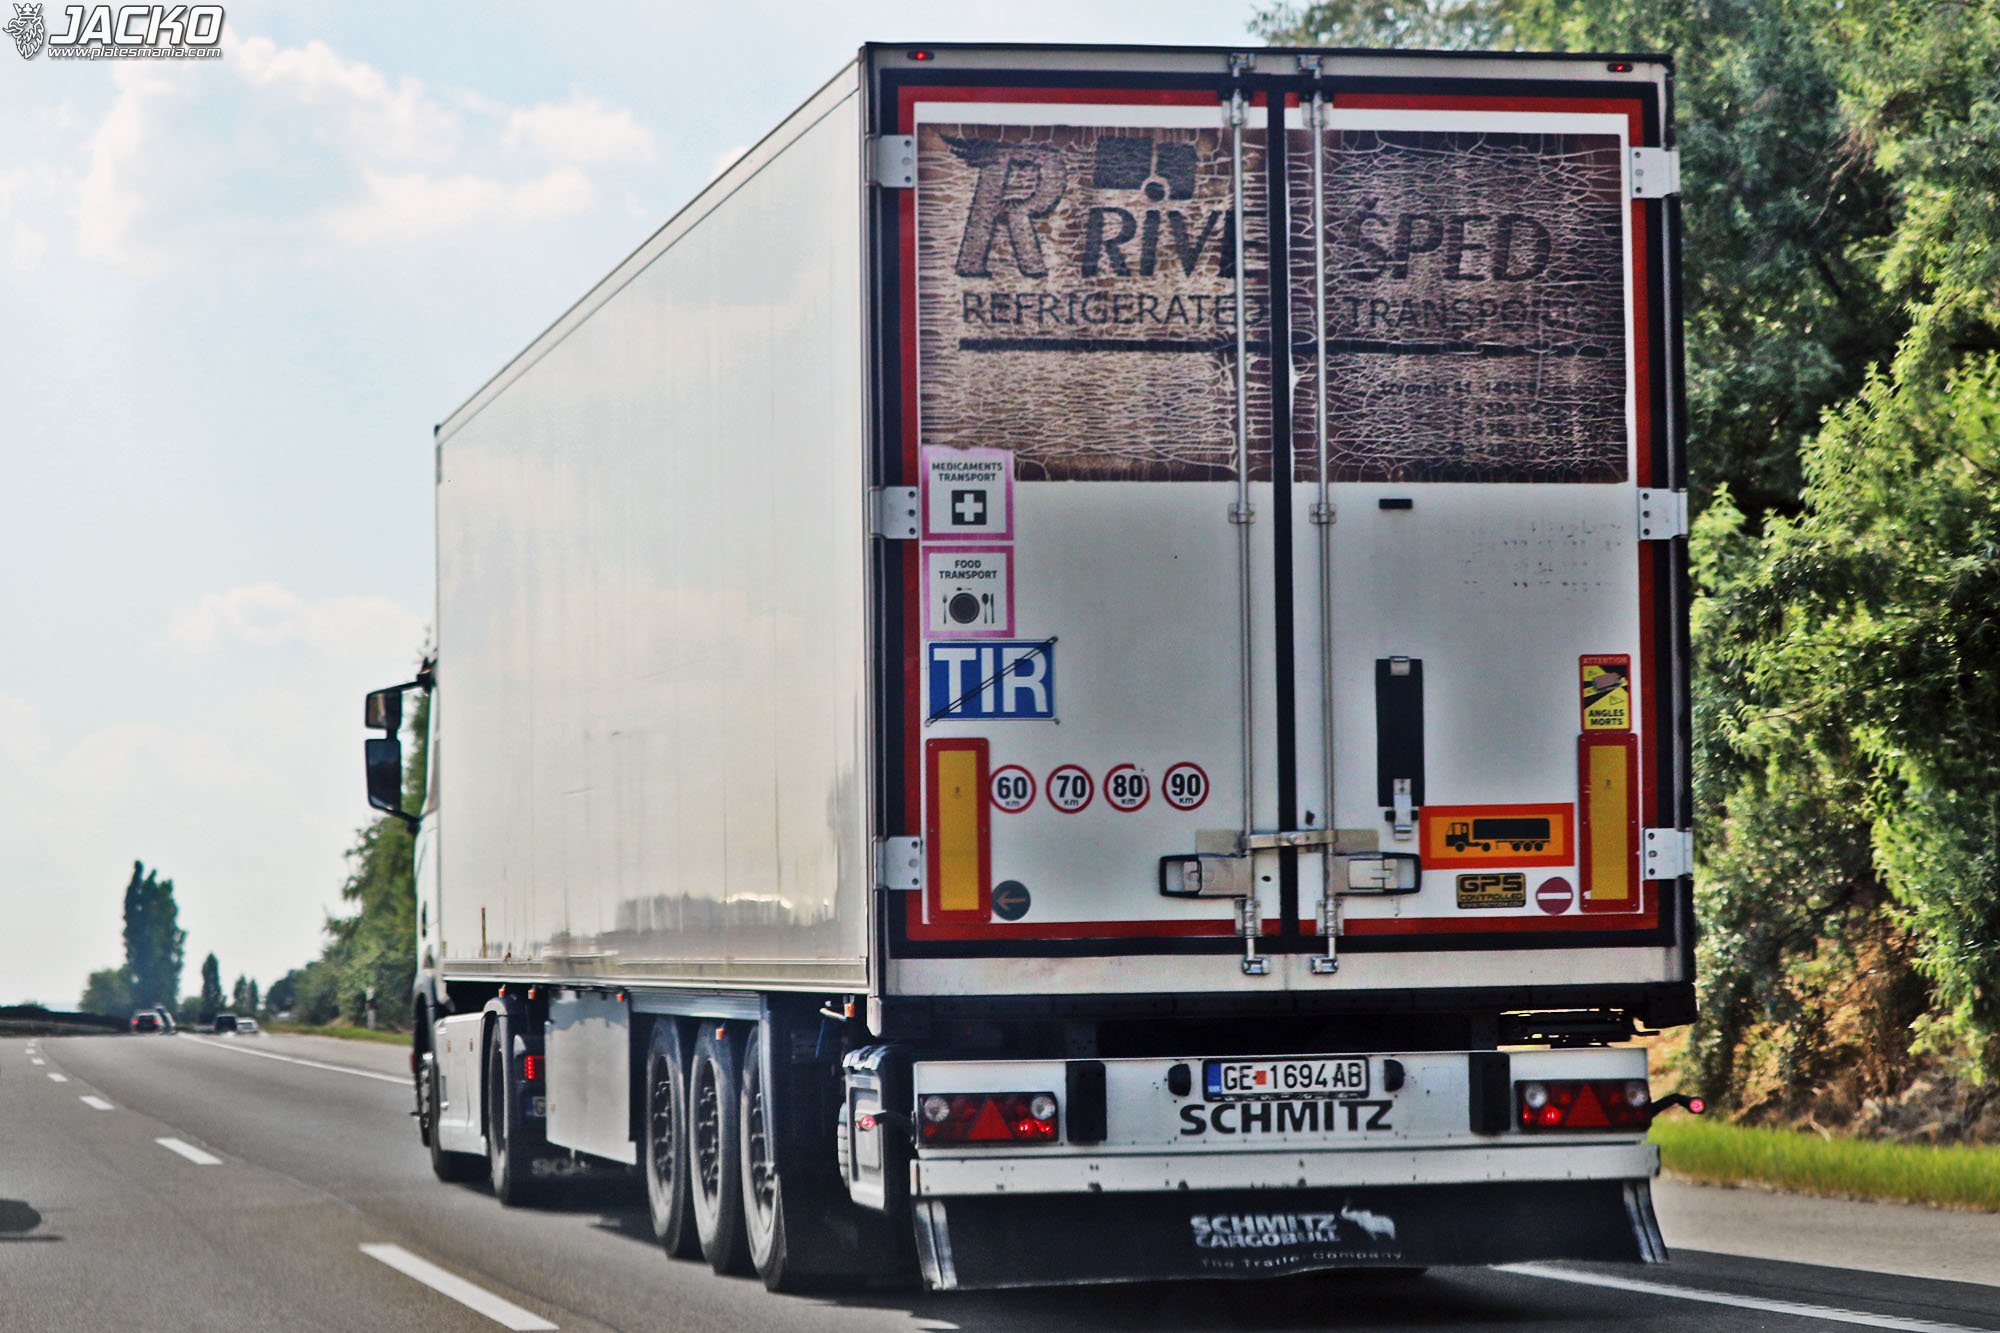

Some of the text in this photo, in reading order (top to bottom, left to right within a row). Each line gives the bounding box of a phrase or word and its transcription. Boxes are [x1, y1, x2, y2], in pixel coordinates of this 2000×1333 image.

[1347, 213, 1551, 281] SPED
[962, 290, 1266, 326] REFRIGERATED
[932, 462, 1003, 472] MEDICAMENTS
[938, 473, 996, 482] TRANSPORT
[939, 570, 998, 580] TRANSPORT
[955, 560, 982, 569] FOOD
[933, 648, 1049, 714] TIR
[1588, 708, 1625, 718] ANGLES
[1590, 718, 1623, 726] MORTS
[997, 776, 1028, 800] 60
[1056, 775, 1087, 799] 70
[1113, 774, 1143, 798] 80
[1171, 773, 1201, 797] 90
[1460, 875, 1523, 892] GPS
[1223, 1065, 1253, 1091] GE
[1179, 1100, 1393, 1136] SCHMITZ
[1190, 1212, 1337, 1235] SCHMITZ
